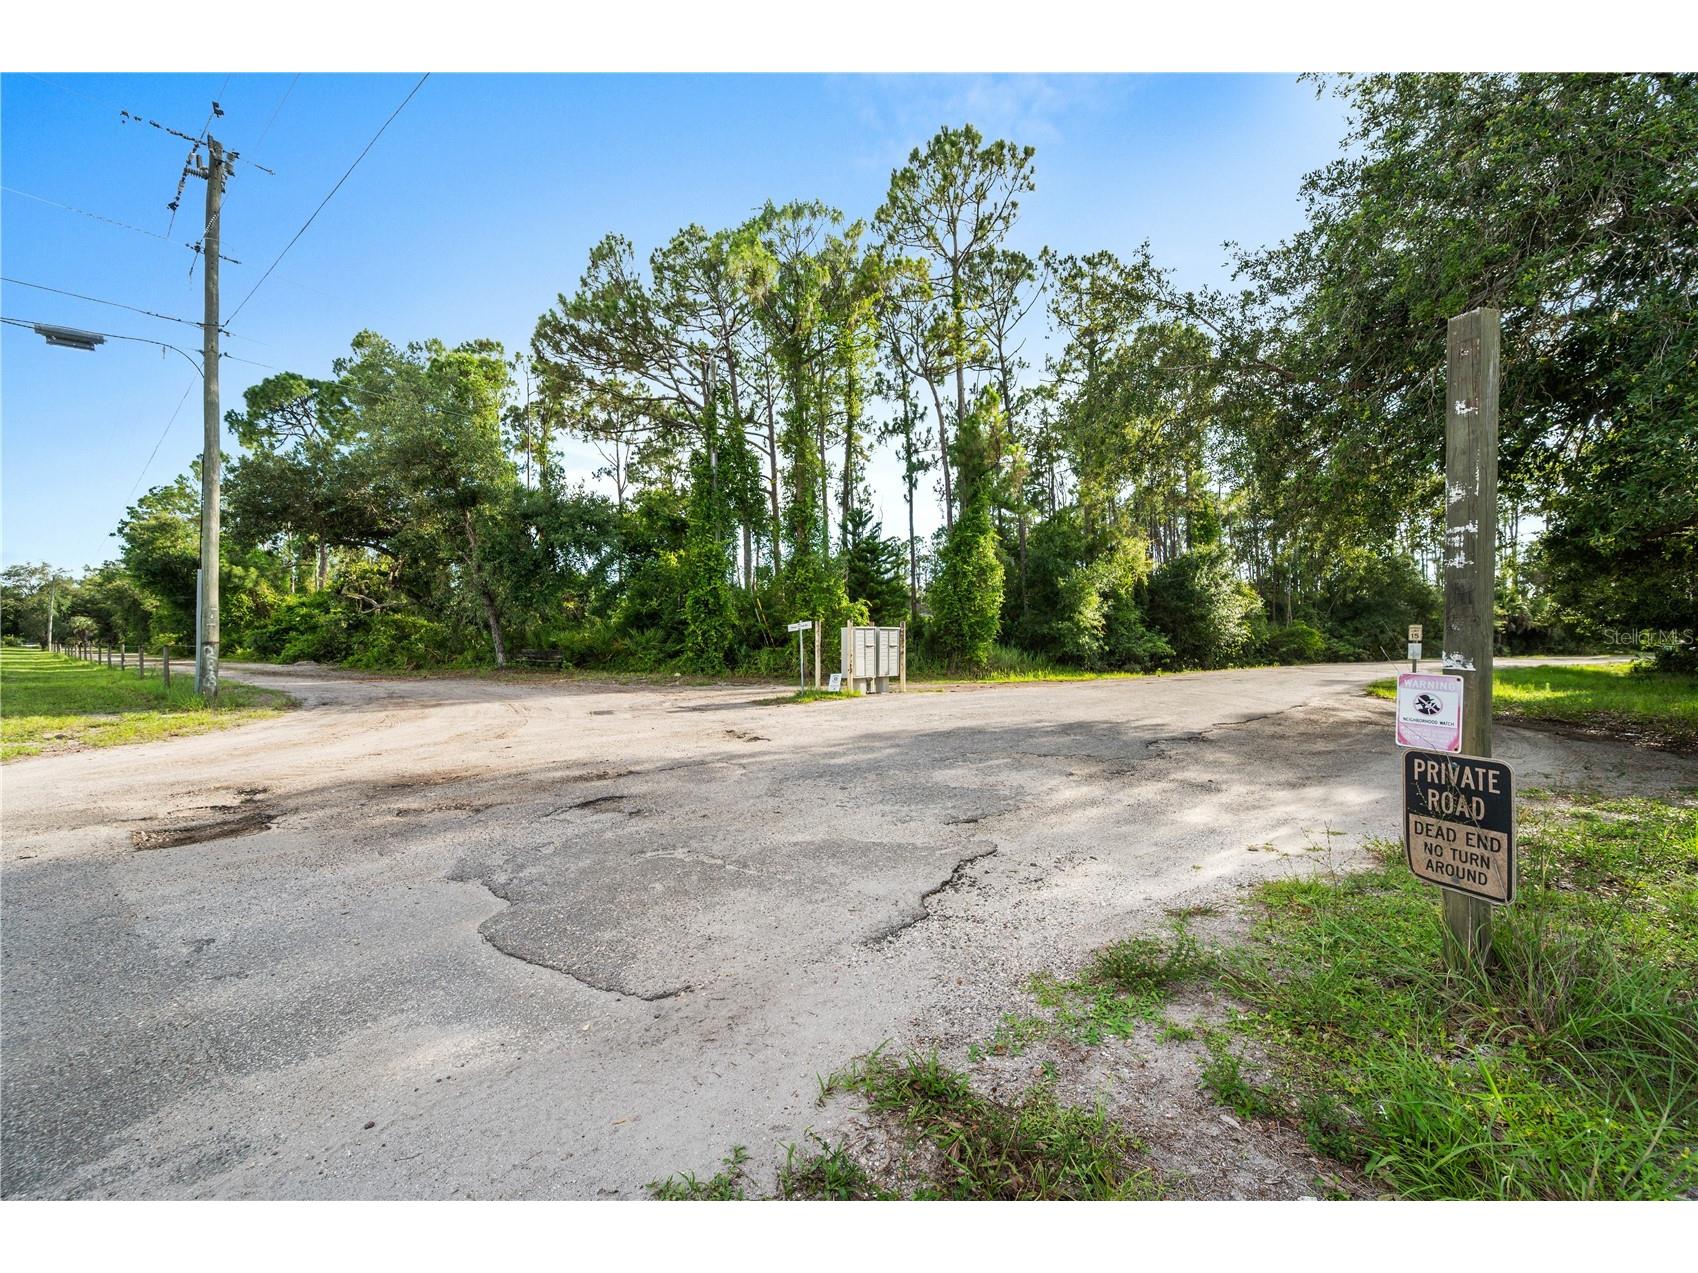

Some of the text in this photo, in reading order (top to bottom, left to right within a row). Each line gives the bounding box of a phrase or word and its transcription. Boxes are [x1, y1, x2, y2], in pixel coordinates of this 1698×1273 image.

[1404, 679, 1456, 690] WARNING
[1402, 717, 1438, 725] NEIGHBORHOOD
[1413, 758, 1501, 794] PRIVATE
[1427, 788, 1485, 821] ROAD
[1414, 820, 1501, 853] DEAD END
[1424, 841, 1490, 870] NO TURN
[1426, 858, 1488, 886] AROUND
